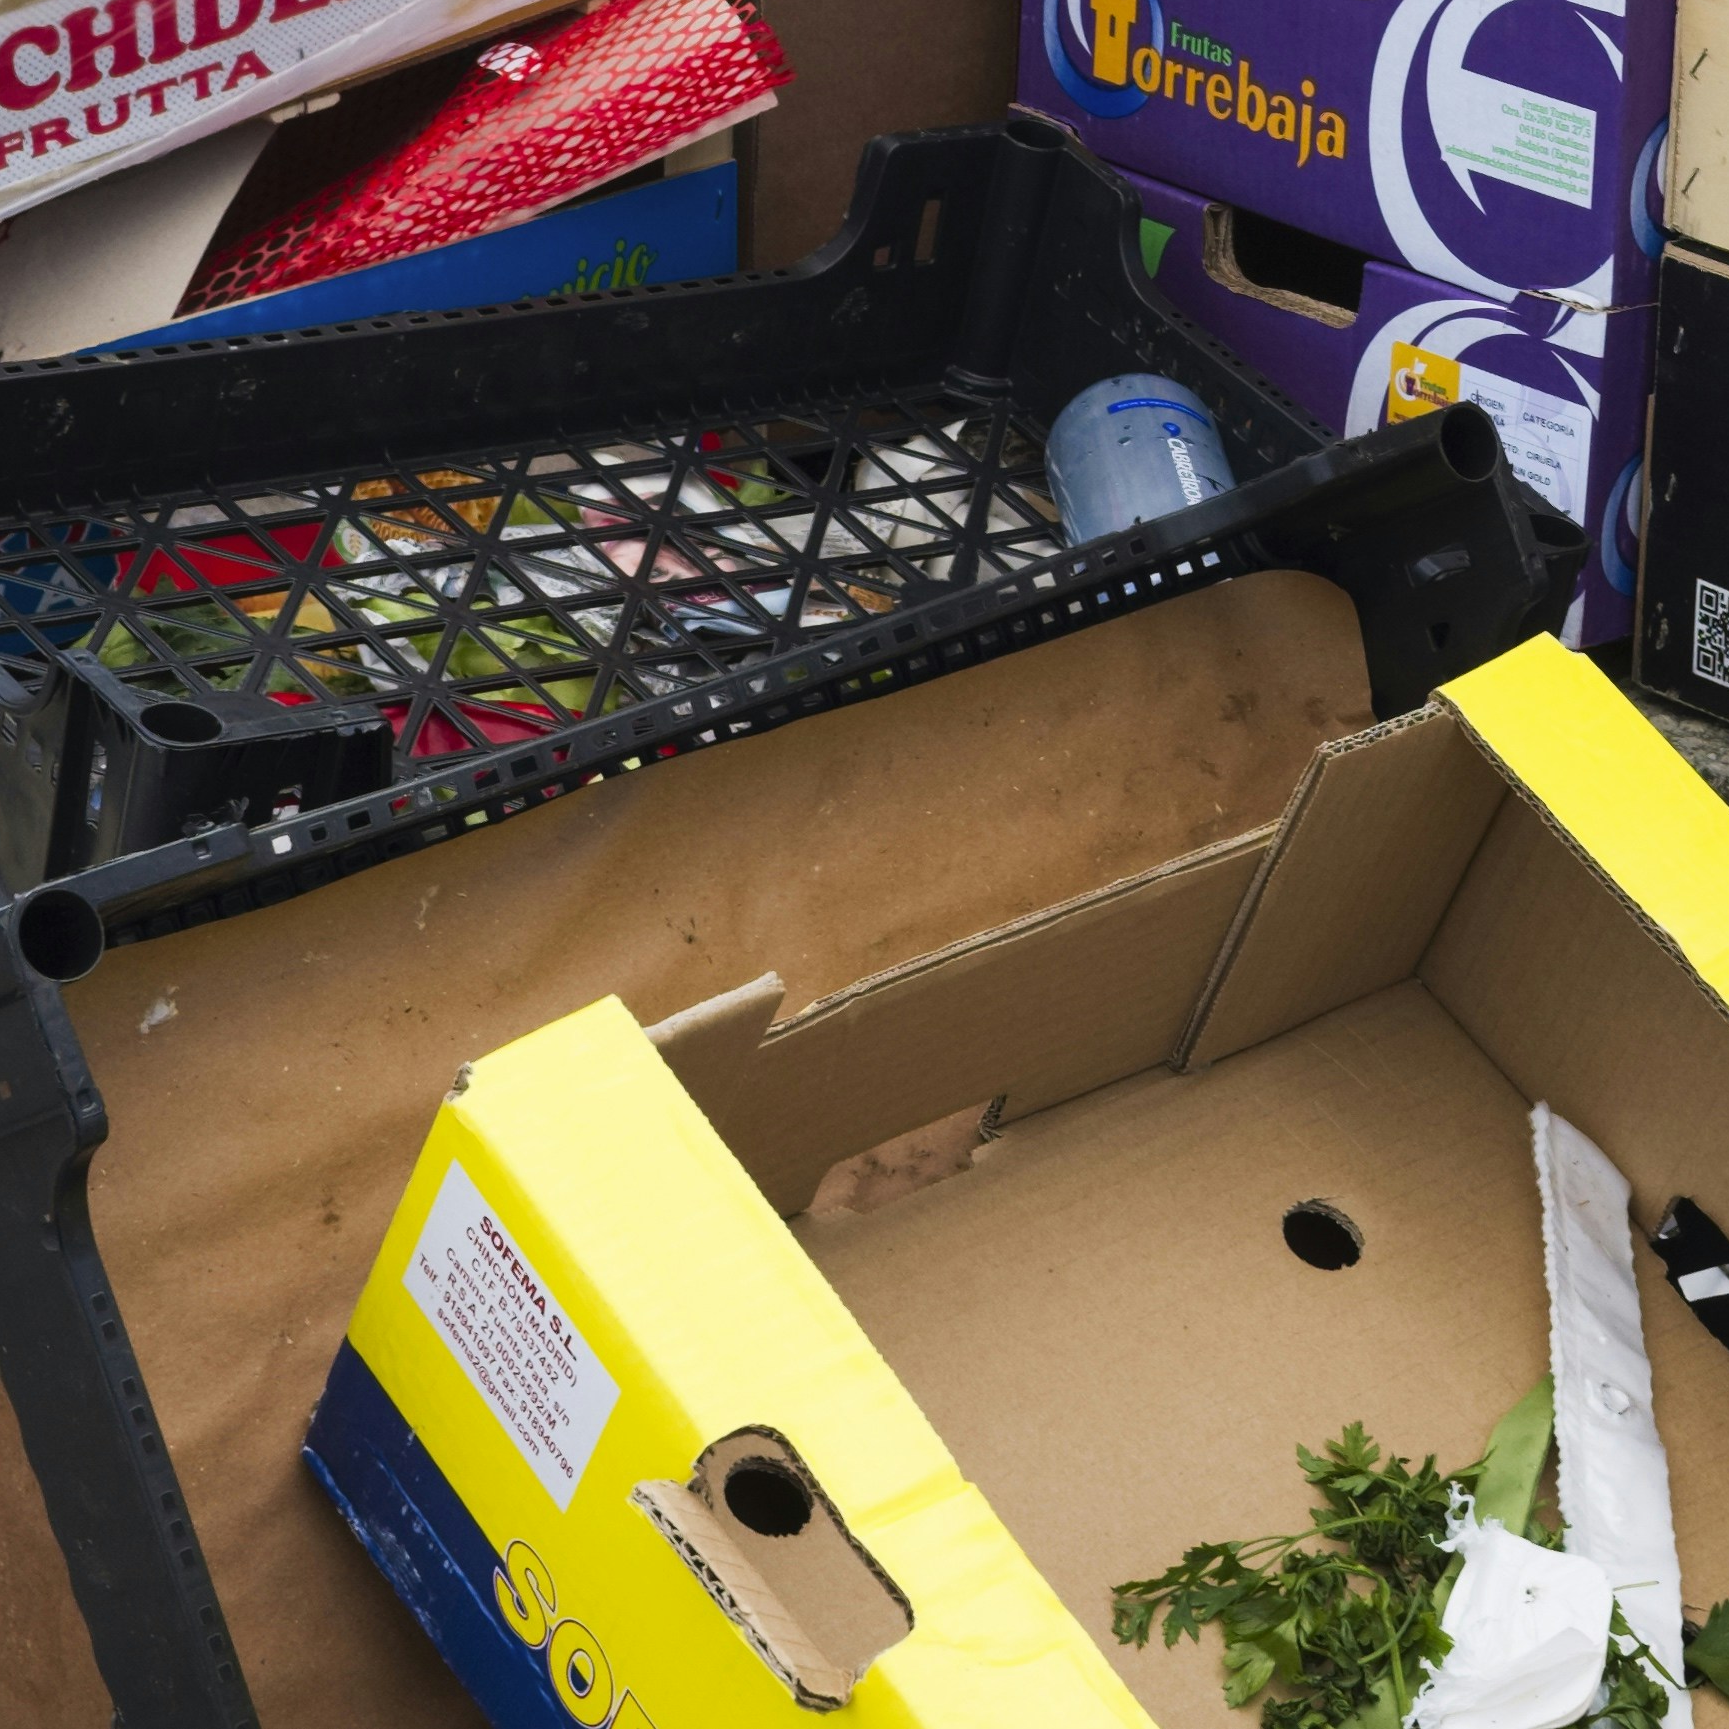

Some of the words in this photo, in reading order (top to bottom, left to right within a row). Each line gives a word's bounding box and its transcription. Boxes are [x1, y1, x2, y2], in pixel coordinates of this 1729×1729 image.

[1170, 21, 1233, 68] Frutas
[1526, 451, 1562, 470] CIRUELA
[1527, 471, 1551, 486] GOLD
[480, 1214, 546, 1317] SOFEMA
[446, 1247, 486, 1305] Camino
[487, 1305, 524, 1360] Fuente
[553, 1400, 571, 1427] s/n
[465, 1226, 525, 1312] CHINCHÓN
[525, 1310, 578, 1388] (MADRID)
